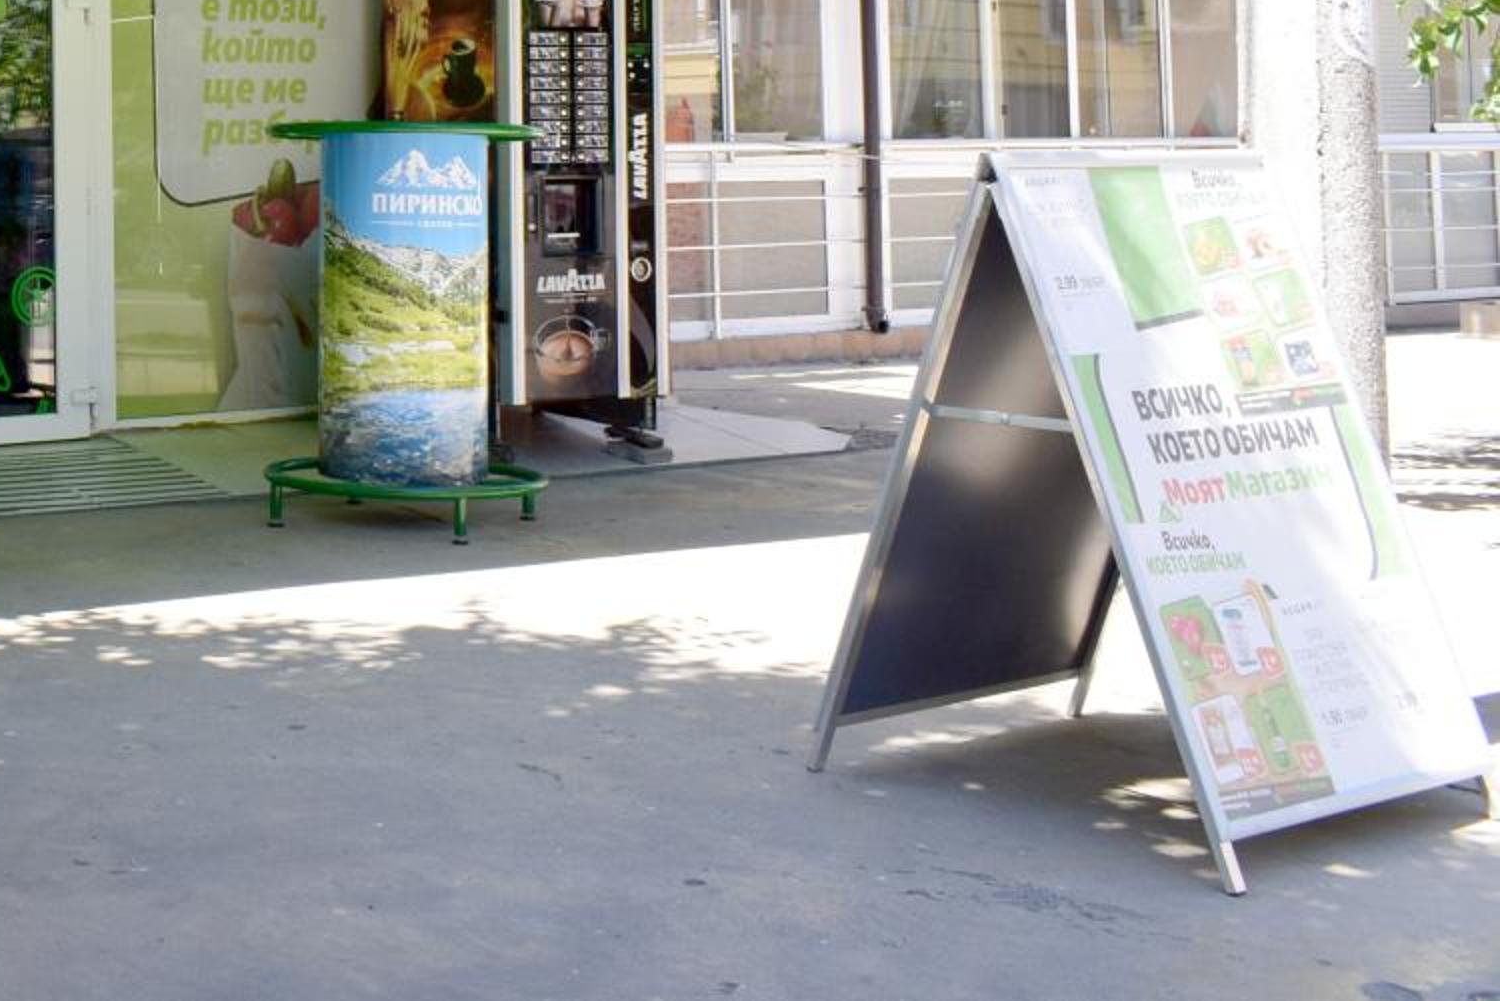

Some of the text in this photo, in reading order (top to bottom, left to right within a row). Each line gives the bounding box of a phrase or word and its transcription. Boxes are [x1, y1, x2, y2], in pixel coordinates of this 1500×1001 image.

[202, 29, 316, 64] който
[202, 78, 308, 109] ще ме
[628, 113, 648, 199] LAVAZZA
[536, 268, 606, 293] LAVAZZA
[1130, 384, 1232, 420] ВСИЧКО,
[1147, 417, 1320, 465] КОЕТО ОБИЧАМ
